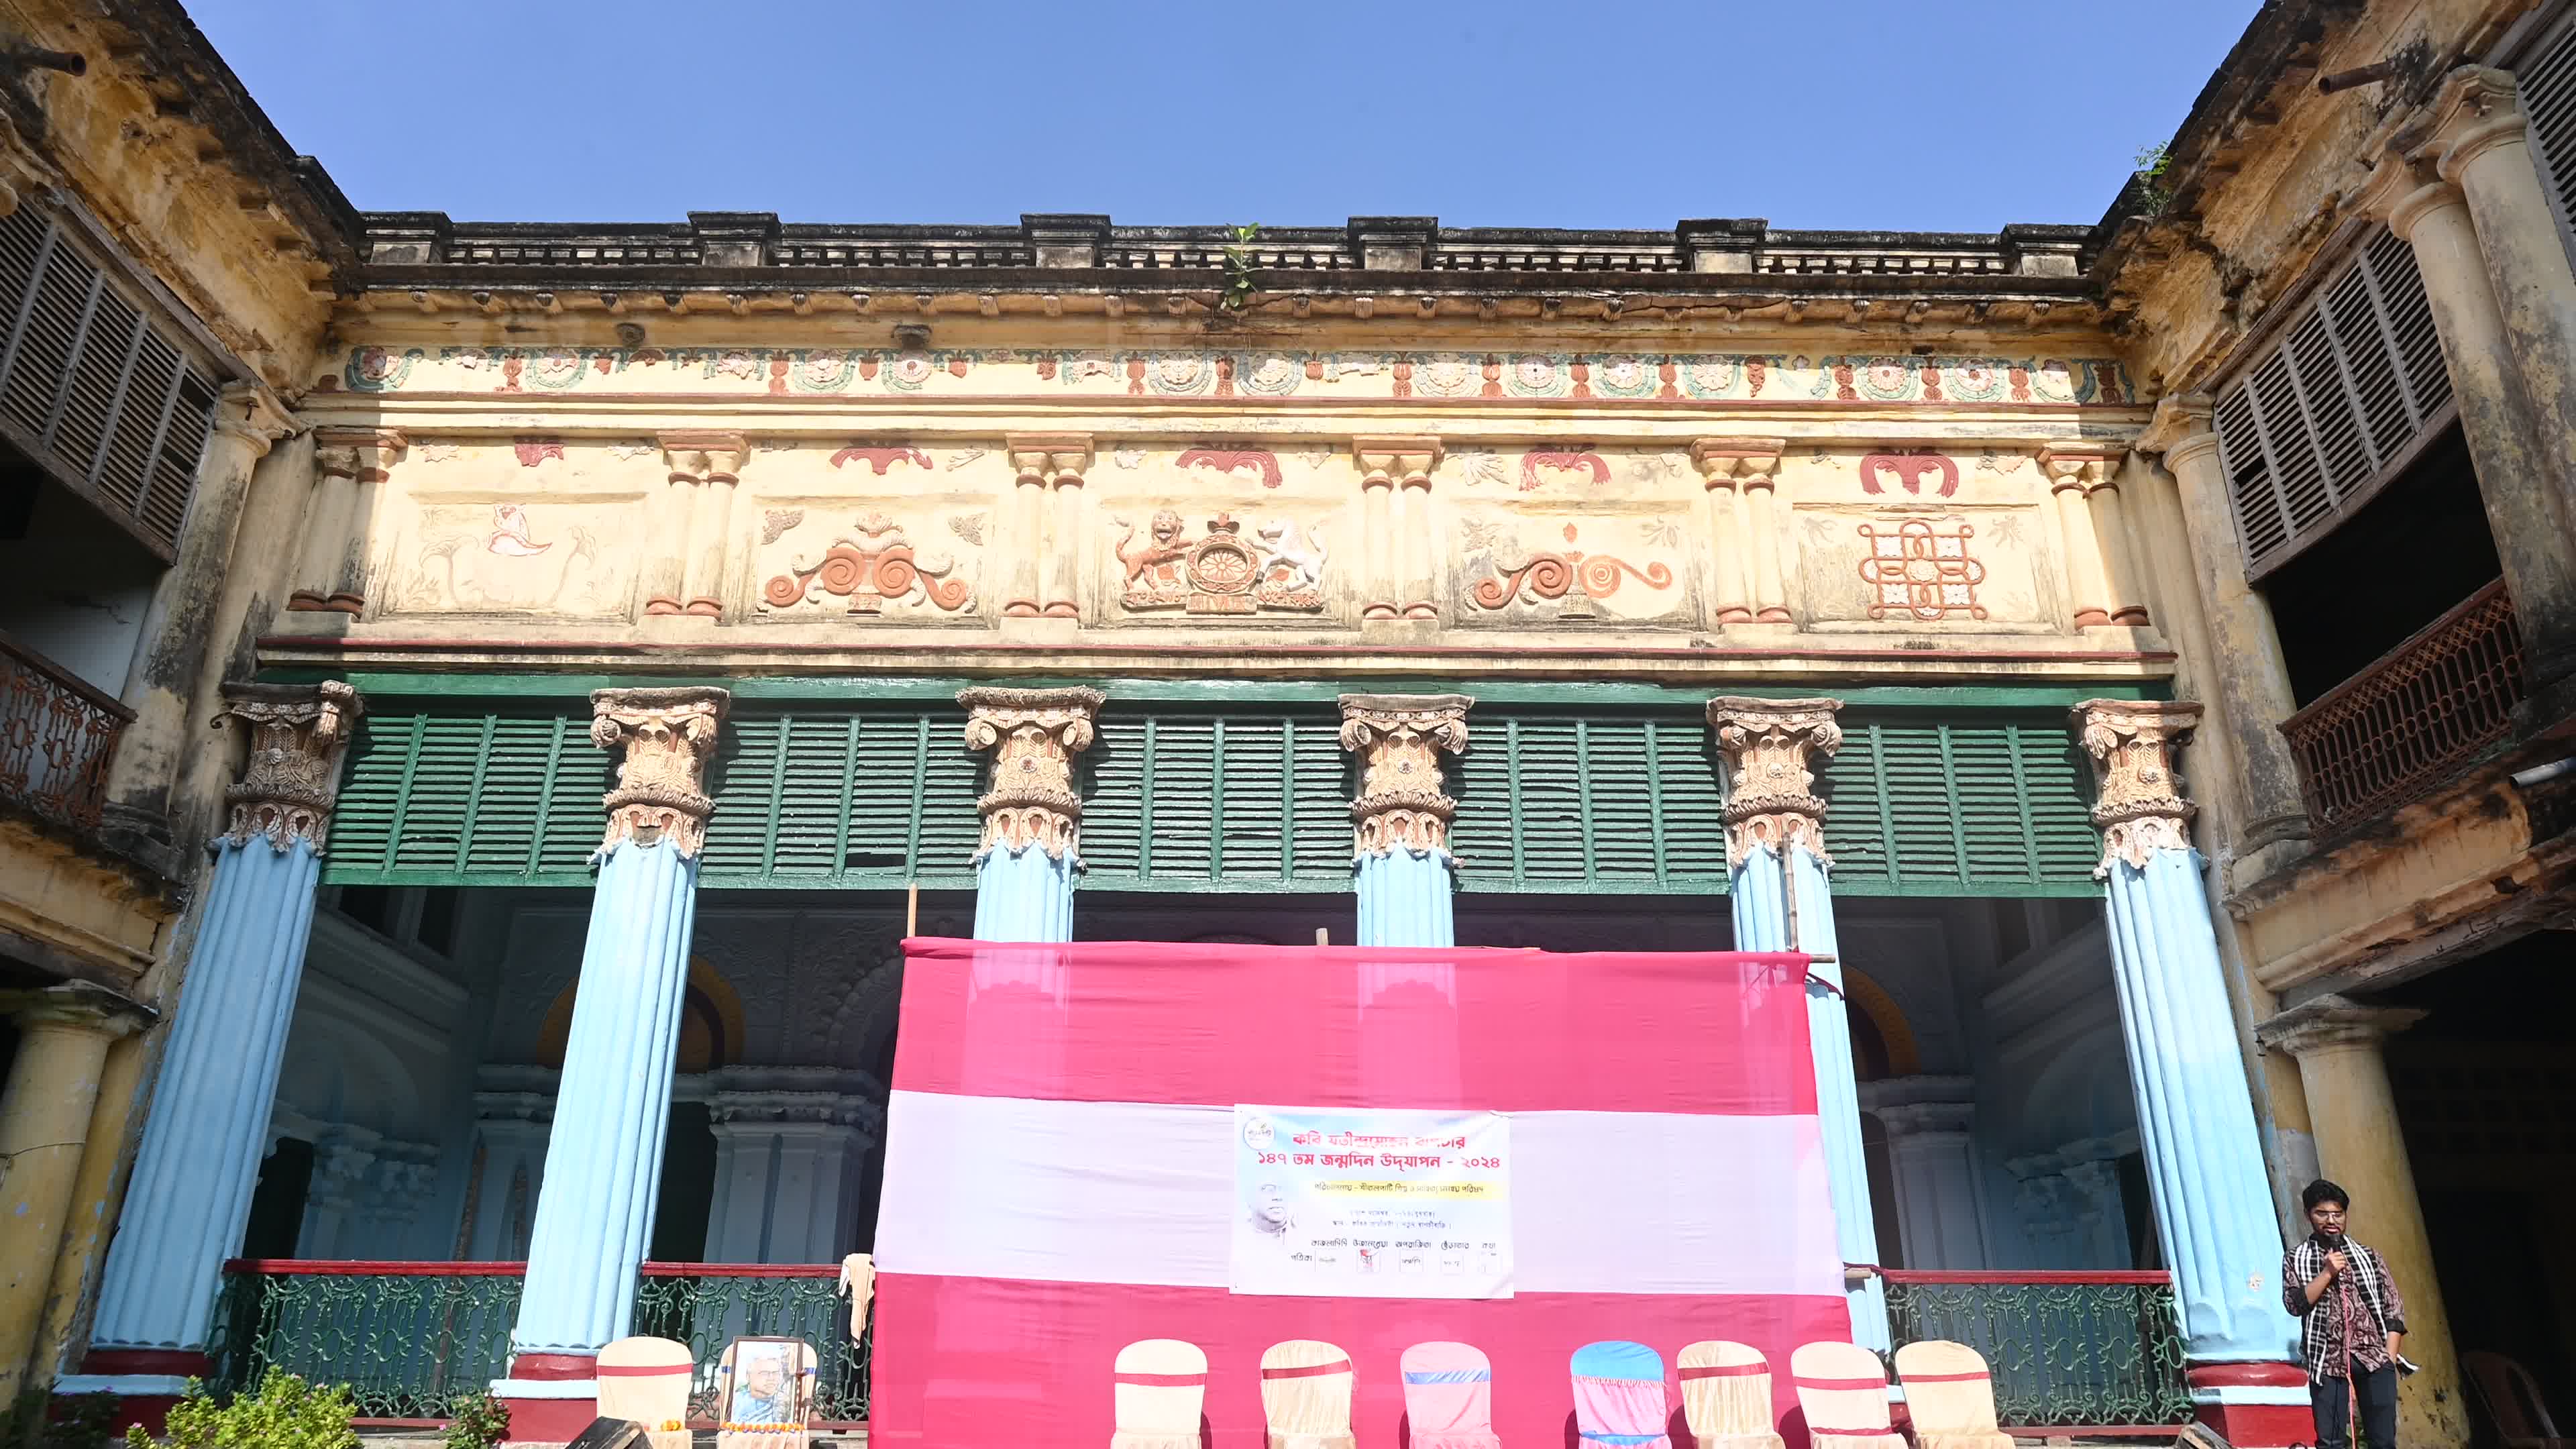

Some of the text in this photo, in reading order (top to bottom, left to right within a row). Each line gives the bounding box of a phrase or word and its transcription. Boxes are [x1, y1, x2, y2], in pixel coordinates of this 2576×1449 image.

[1258, 1152, 1287, 1165] ১৪৭
[1293, 1153, 1315, 1165] তম
[1320, 1151, 1374, 1168] জন্মদিন
[1461, 1156, 1500, 1169] ২০২৪
